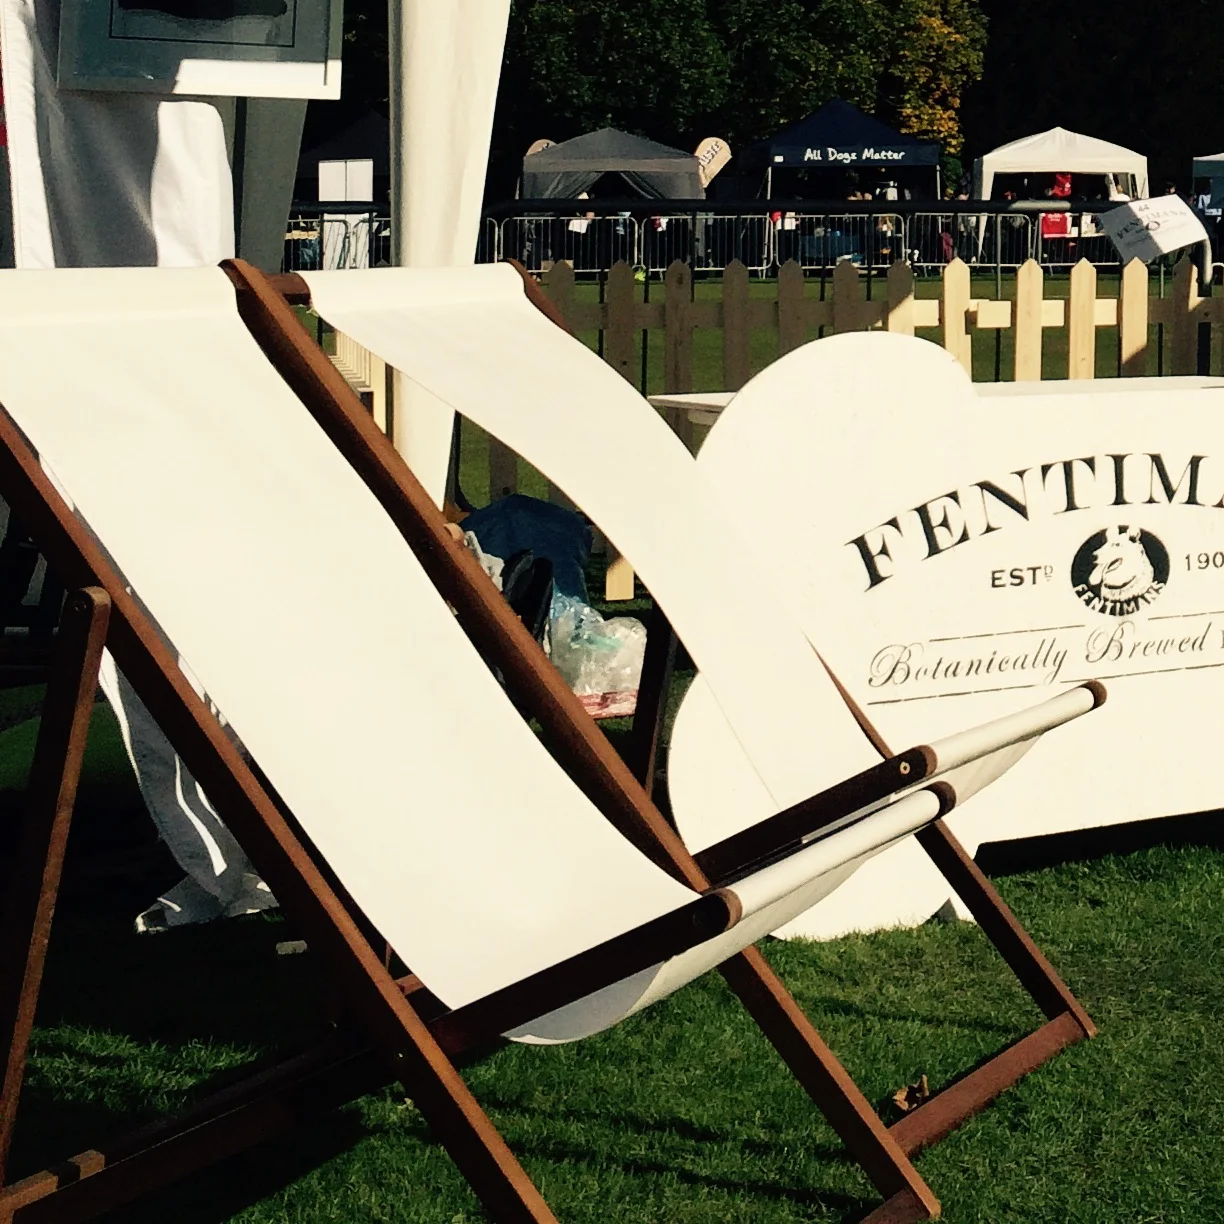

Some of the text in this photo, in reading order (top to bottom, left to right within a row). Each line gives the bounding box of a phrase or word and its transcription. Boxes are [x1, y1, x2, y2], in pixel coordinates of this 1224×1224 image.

[804, 147, 906, 164] All Dogs Matter
[1073, 580, 1166, 617] FENTIMANS
[867, 637, 1068, 688] Botanically
[1084, 620, 1211, 666] Brewed
